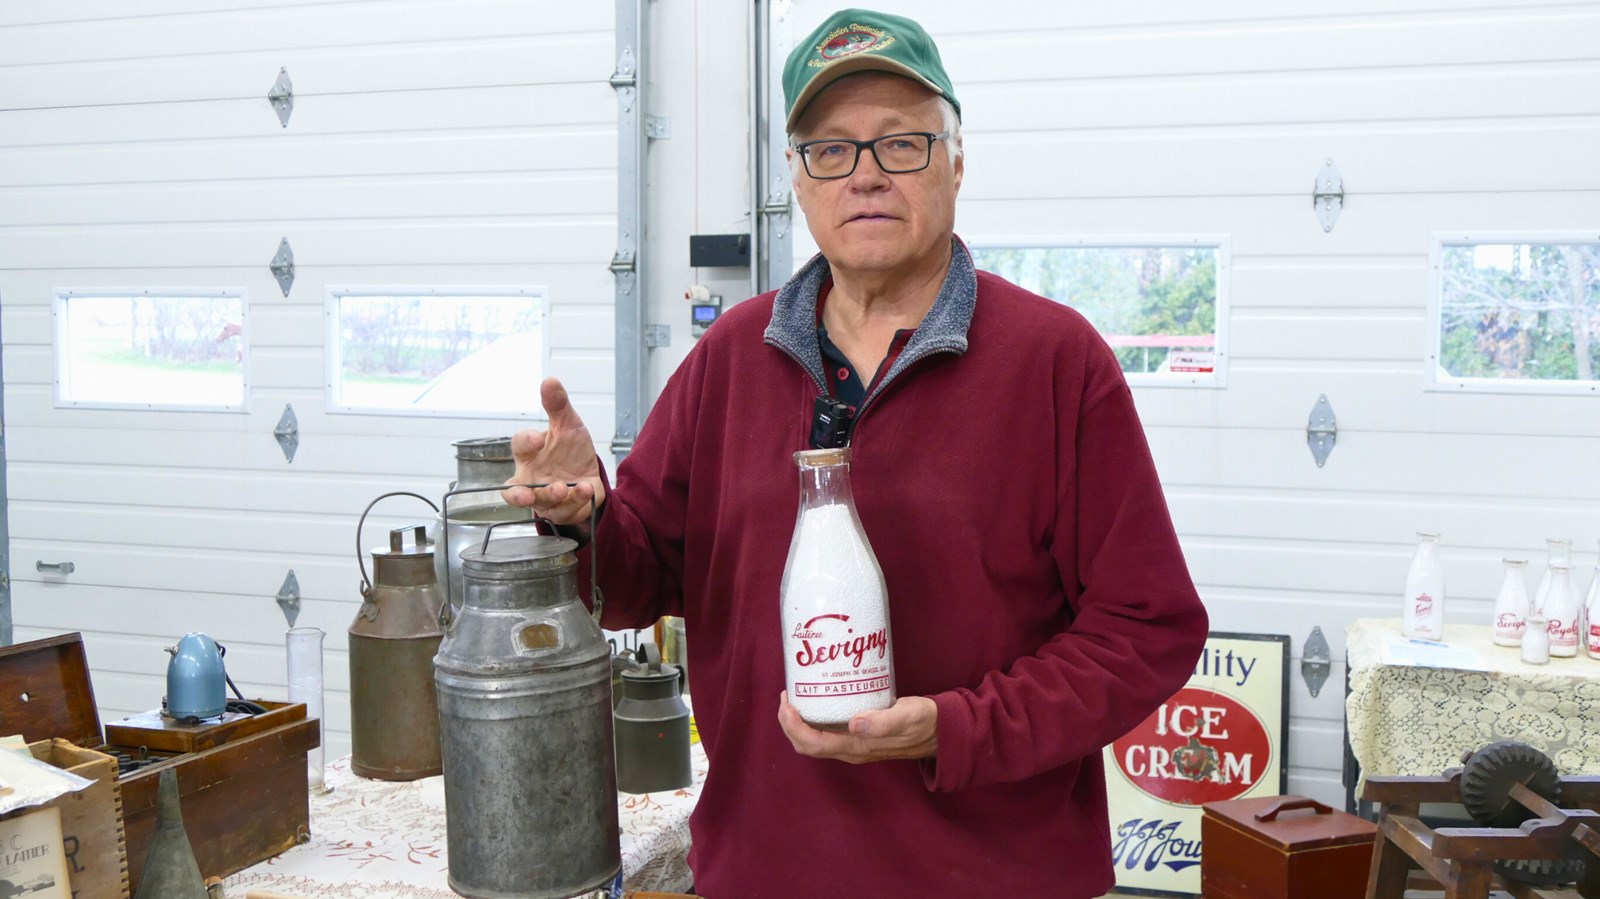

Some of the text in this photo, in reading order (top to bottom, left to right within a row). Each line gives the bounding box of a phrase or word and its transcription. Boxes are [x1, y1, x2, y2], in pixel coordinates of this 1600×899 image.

[1192, 648, 1257, 686] lity
[796, 686, 818, 694] LAIT
[1156, 704, 1229, 739] ICE
